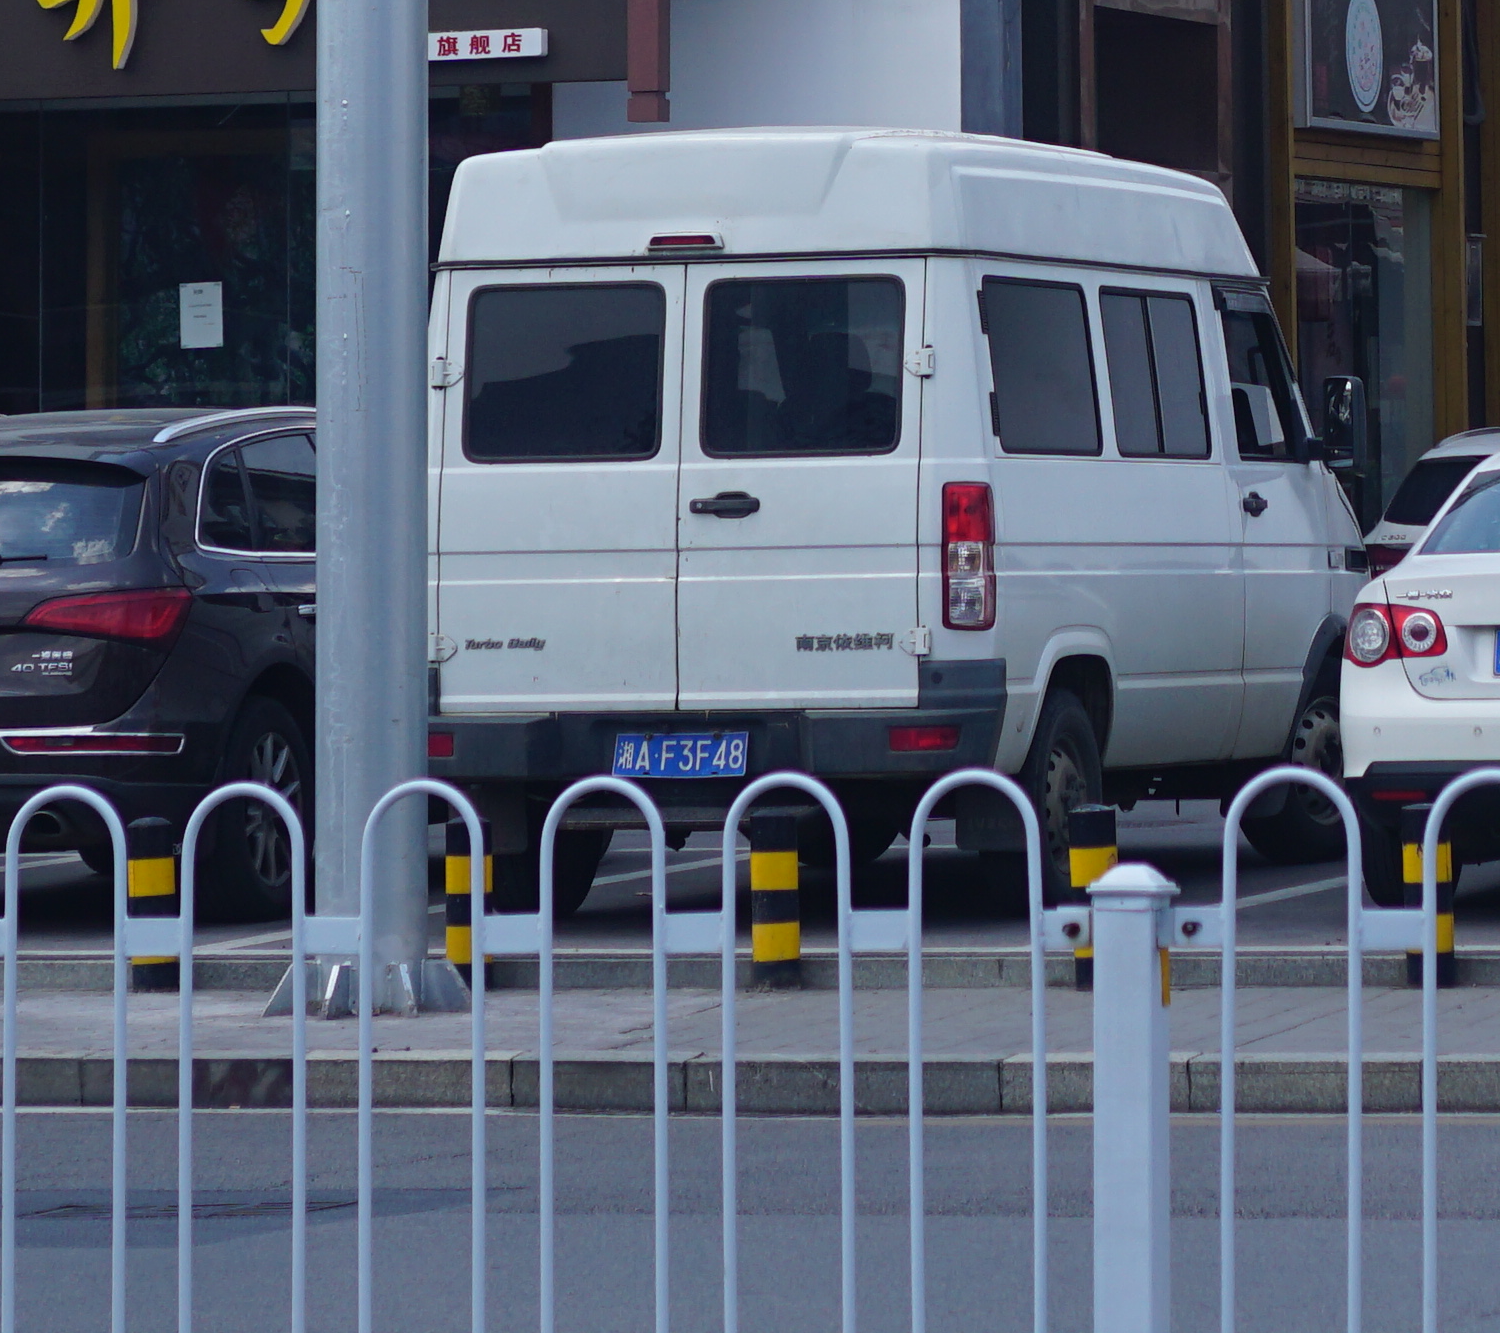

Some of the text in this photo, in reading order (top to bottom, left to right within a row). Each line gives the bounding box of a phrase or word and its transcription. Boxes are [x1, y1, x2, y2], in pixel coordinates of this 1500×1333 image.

[436, 32, 522, 57] 旗舰店
[795, 633, 895, 652] 南京依维柯
[617, 739, 744, 771] 湘A·F3F48
